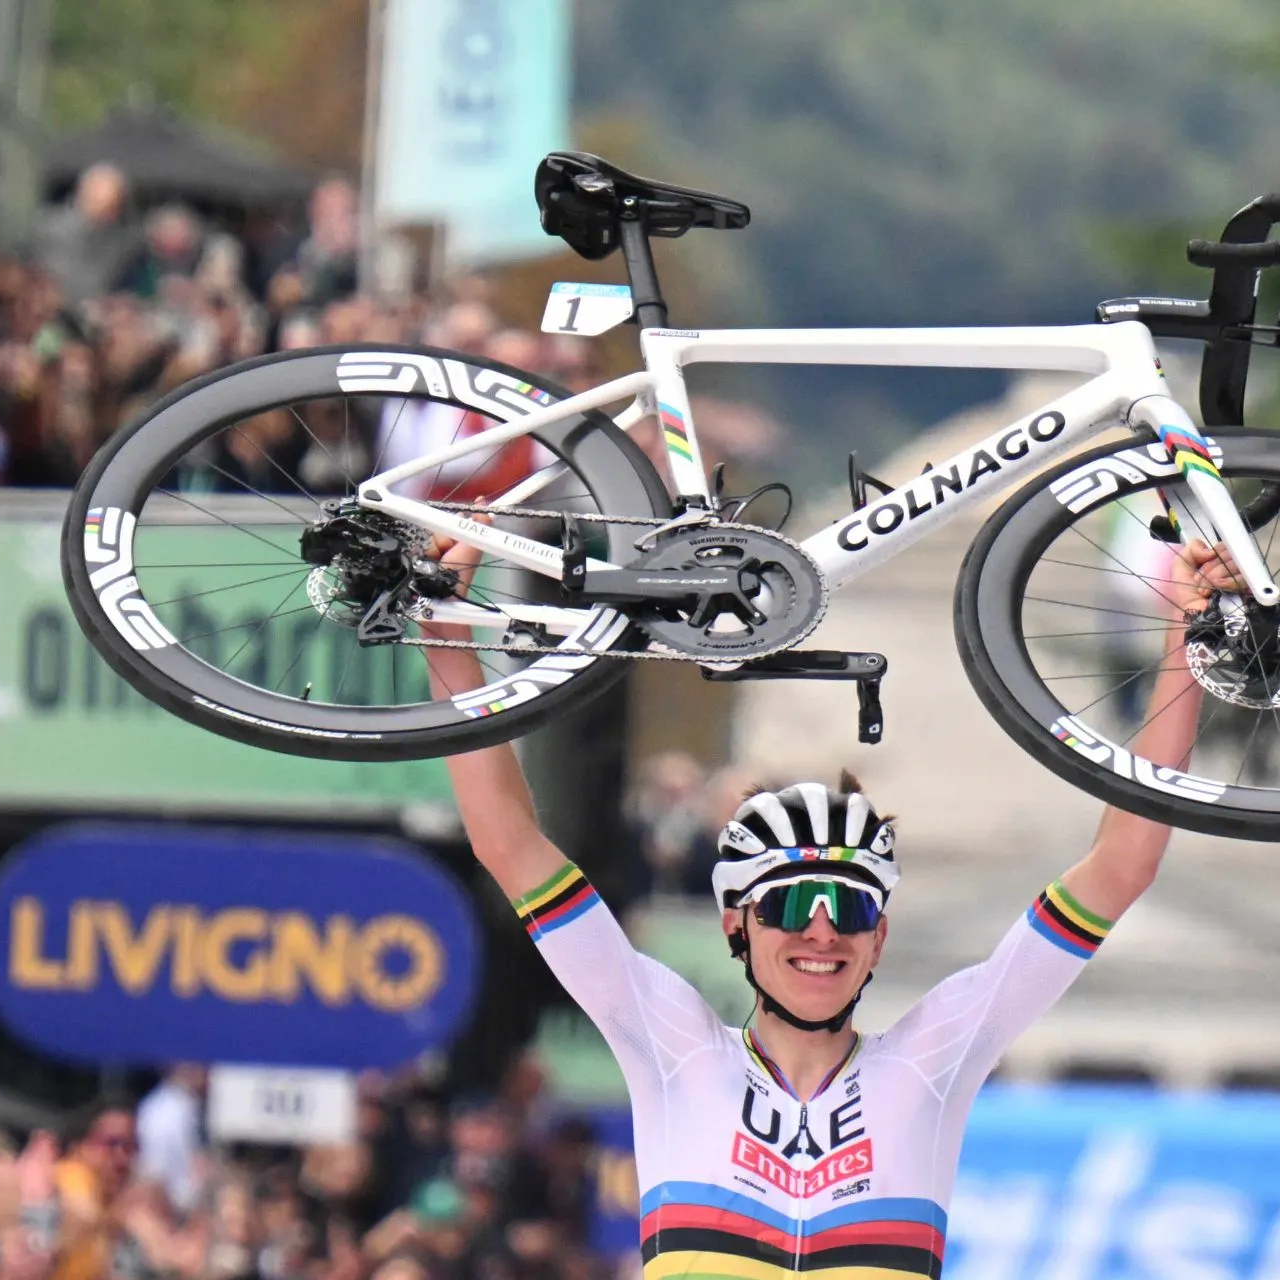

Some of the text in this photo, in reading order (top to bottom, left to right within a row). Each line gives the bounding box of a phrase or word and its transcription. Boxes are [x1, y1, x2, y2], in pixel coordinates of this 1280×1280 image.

[559, 297, 582, 332] 1
[837, 410, 1067, 553] COLNAGO
[457, 518, 490, 538] UAE
[742, 1086, 866, 1160] UAE
[737, 1139, 870, 1199] Emirates
